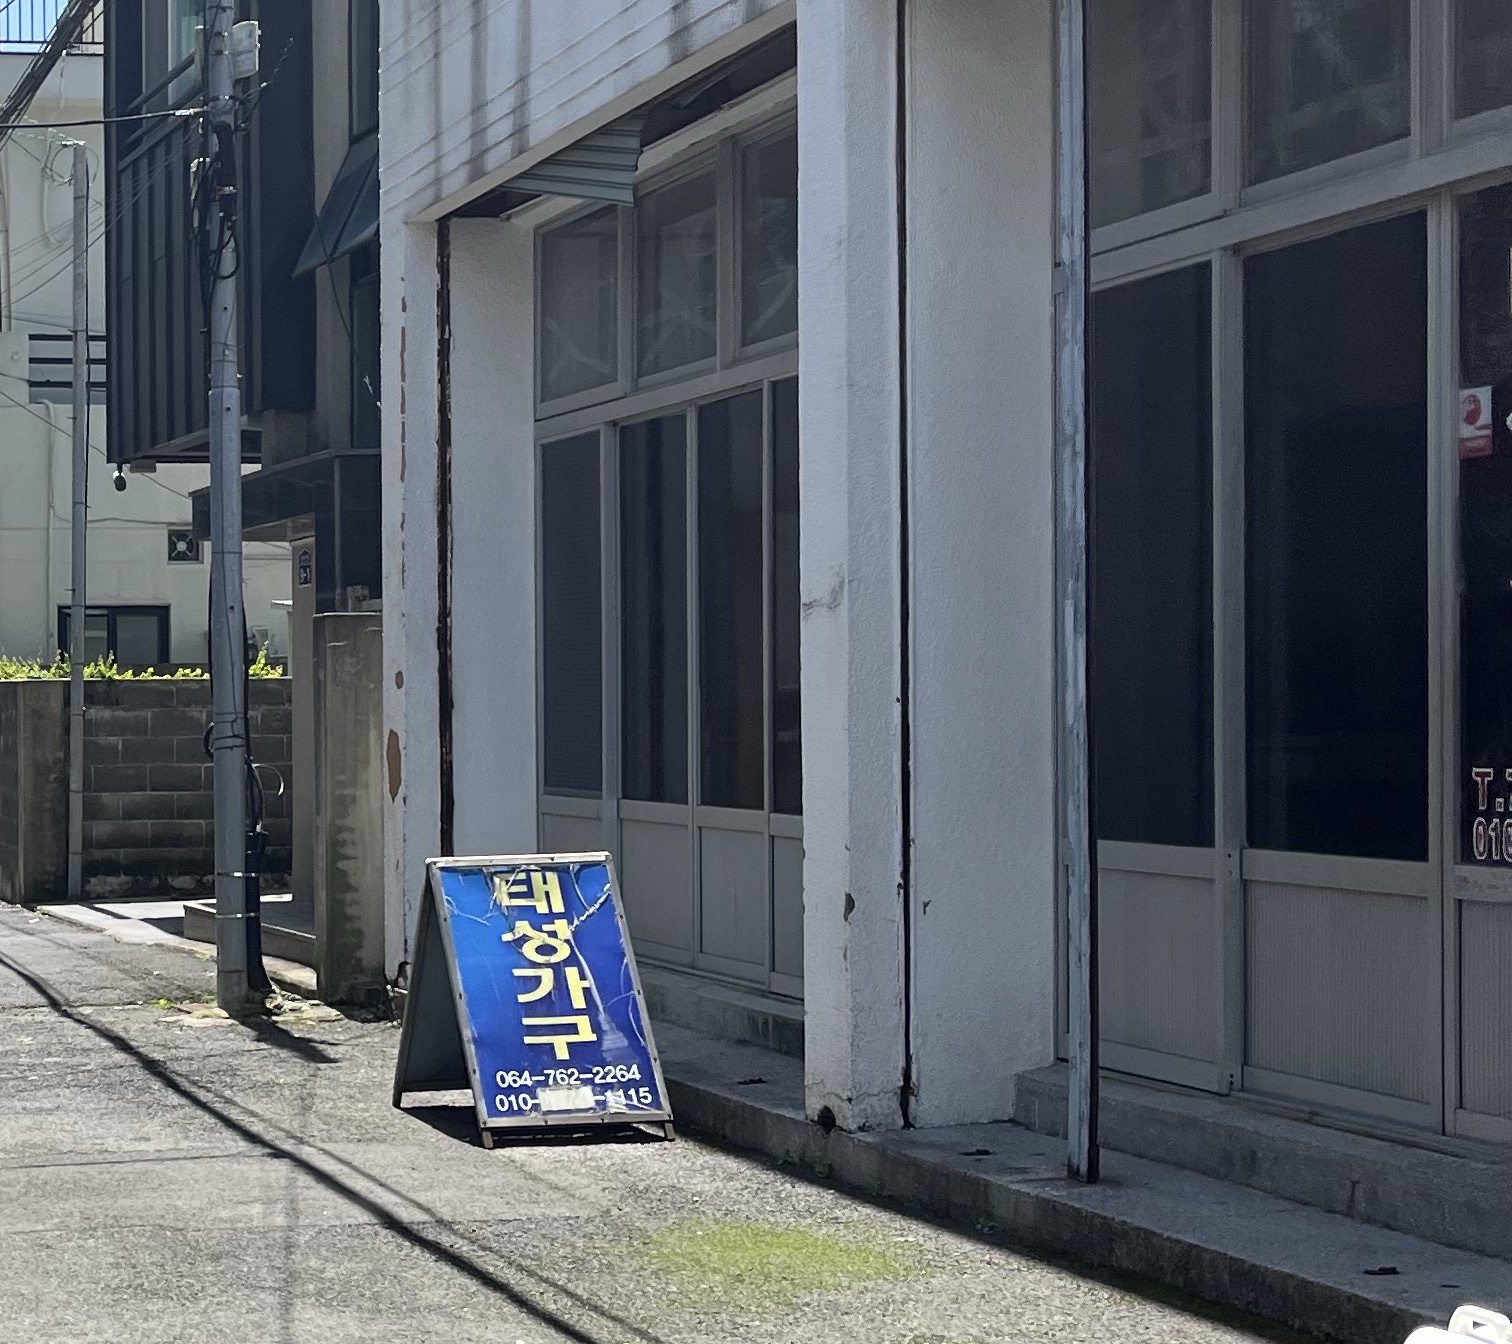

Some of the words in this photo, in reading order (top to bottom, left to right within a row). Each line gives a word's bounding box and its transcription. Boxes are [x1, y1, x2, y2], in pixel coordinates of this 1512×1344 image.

[495, 870, 597, 1060] 태성가구
[495, 1063, 641, 1088] 064-762-2264
[495, 1087, 653, 1112] 010--1115
